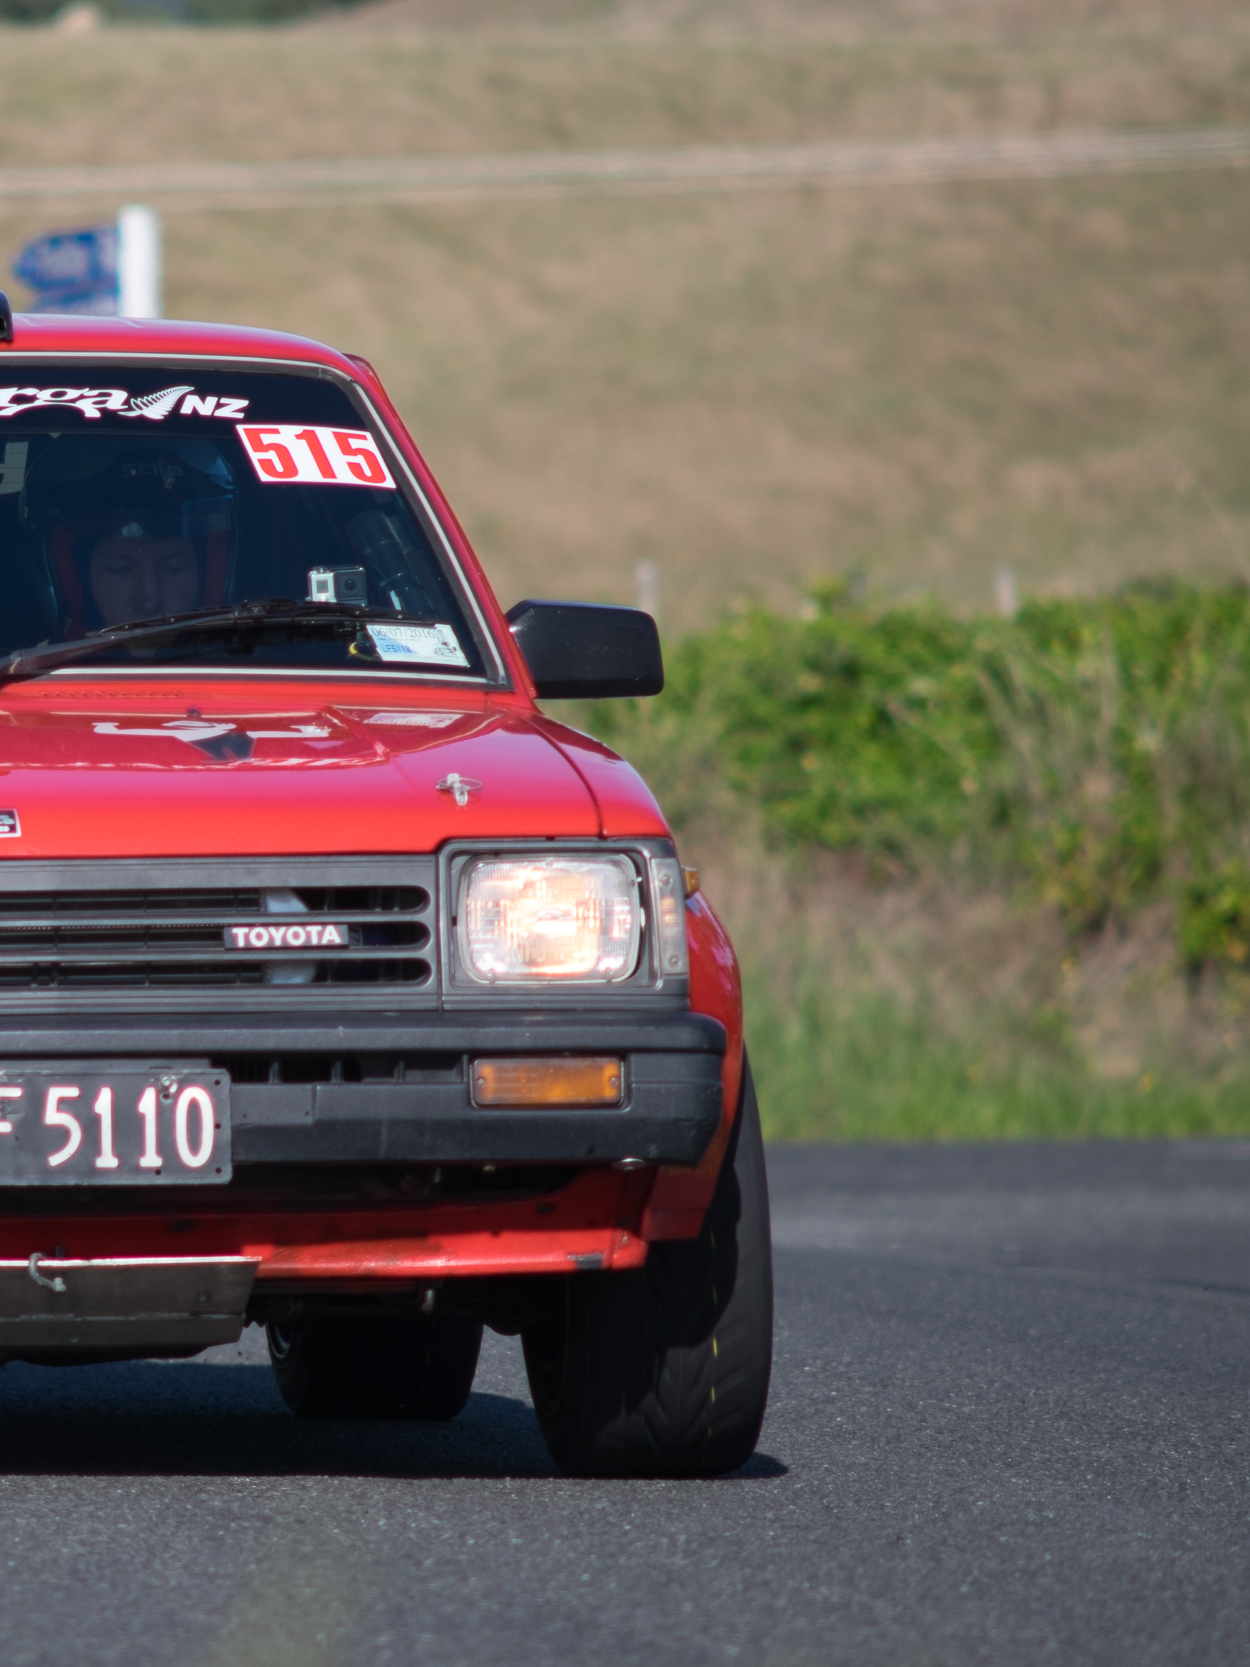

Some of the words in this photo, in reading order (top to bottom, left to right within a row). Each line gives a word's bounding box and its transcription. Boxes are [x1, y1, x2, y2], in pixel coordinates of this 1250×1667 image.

[179, 395, 250, 419] NZ
[242, 427, 387, 484] 515
[232, 924, 341, 948] TOYOTA
[44, 1086, 216, 1168] 5110
